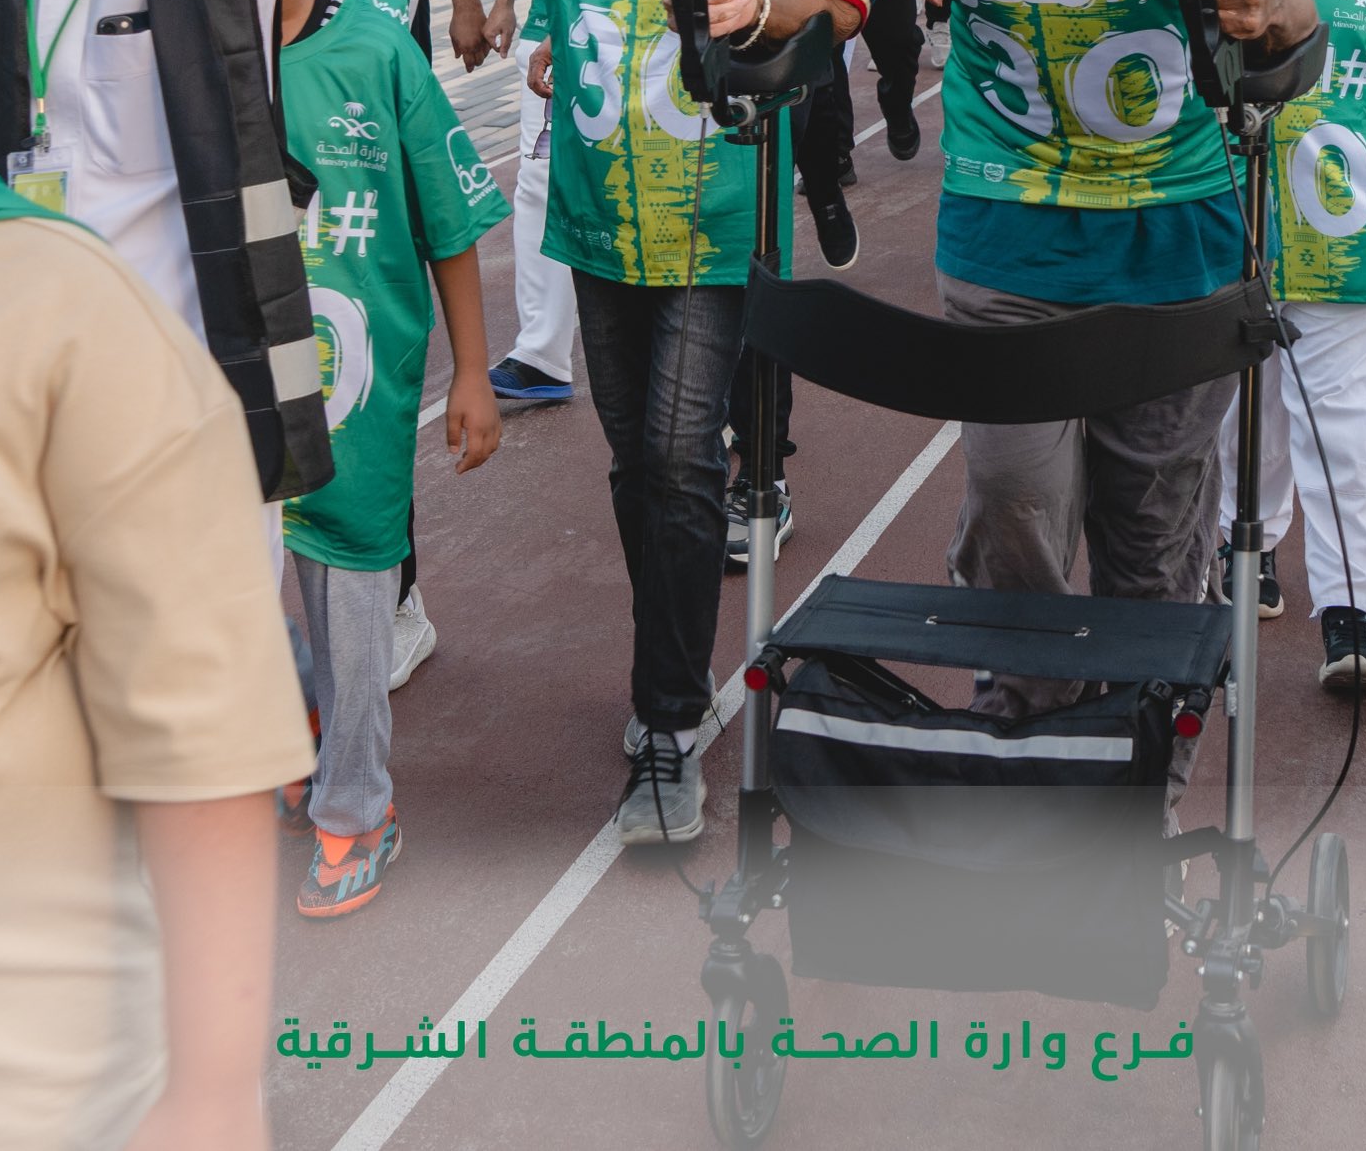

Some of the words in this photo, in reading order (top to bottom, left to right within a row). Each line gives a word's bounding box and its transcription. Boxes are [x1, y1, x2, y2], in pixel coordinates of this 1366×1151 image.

[967, 12, 1192, 143] 30
[316, 140, 358, 156] الصحة
[359, 146, 389, 164] وزارة
[315, 157, 349, 169] Ministry
